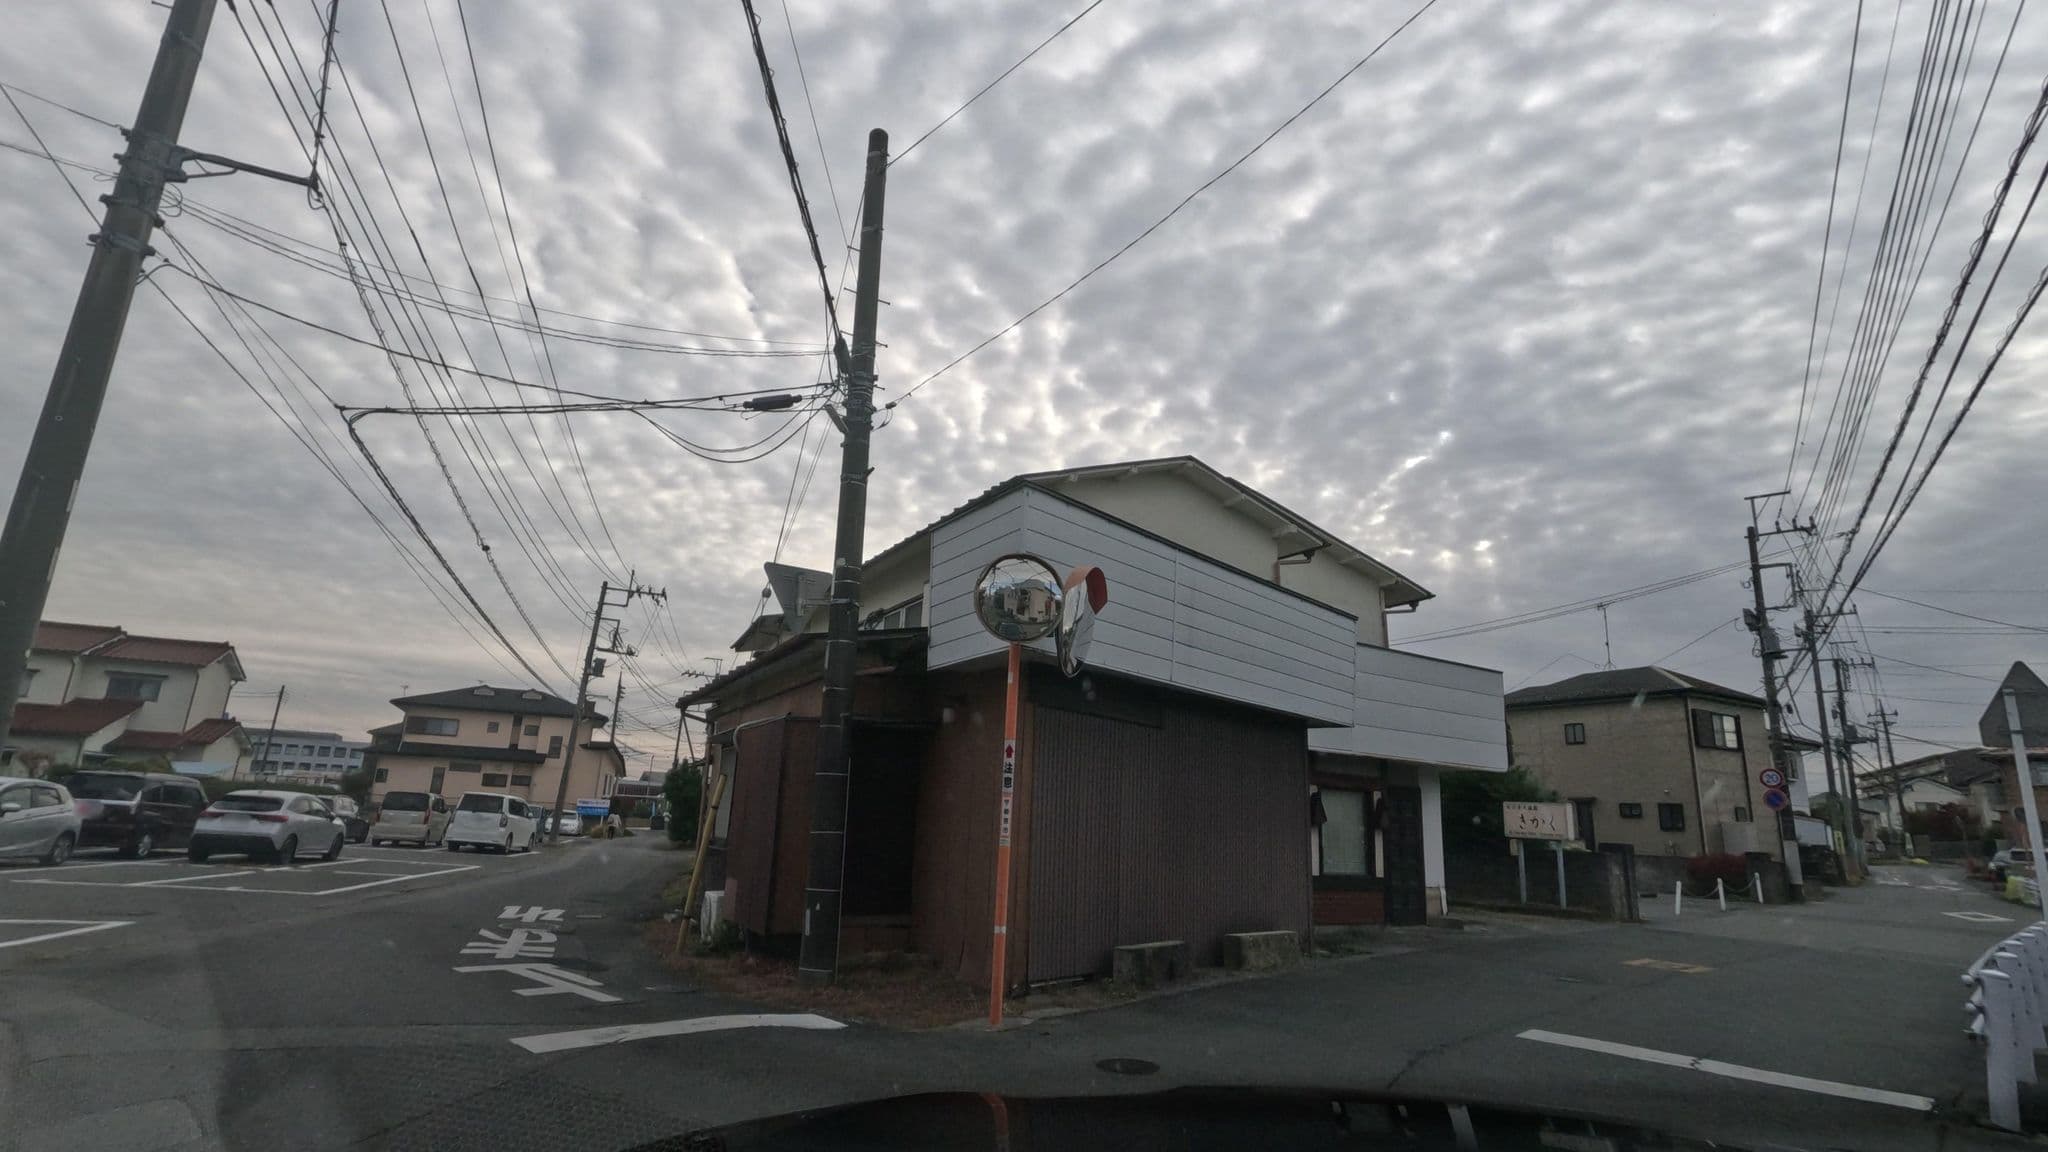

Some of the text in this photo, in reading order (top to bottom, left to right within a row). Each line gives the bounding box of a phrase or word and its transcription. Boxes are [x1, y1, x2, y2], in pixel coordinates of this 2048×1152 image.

[1003, 761, 1014, 789] 注意
[1764, 773, 1779, 784] 20
[1519, 813, 1556, 832] きかく
[452, 905, 624, 1002] 止まれ
